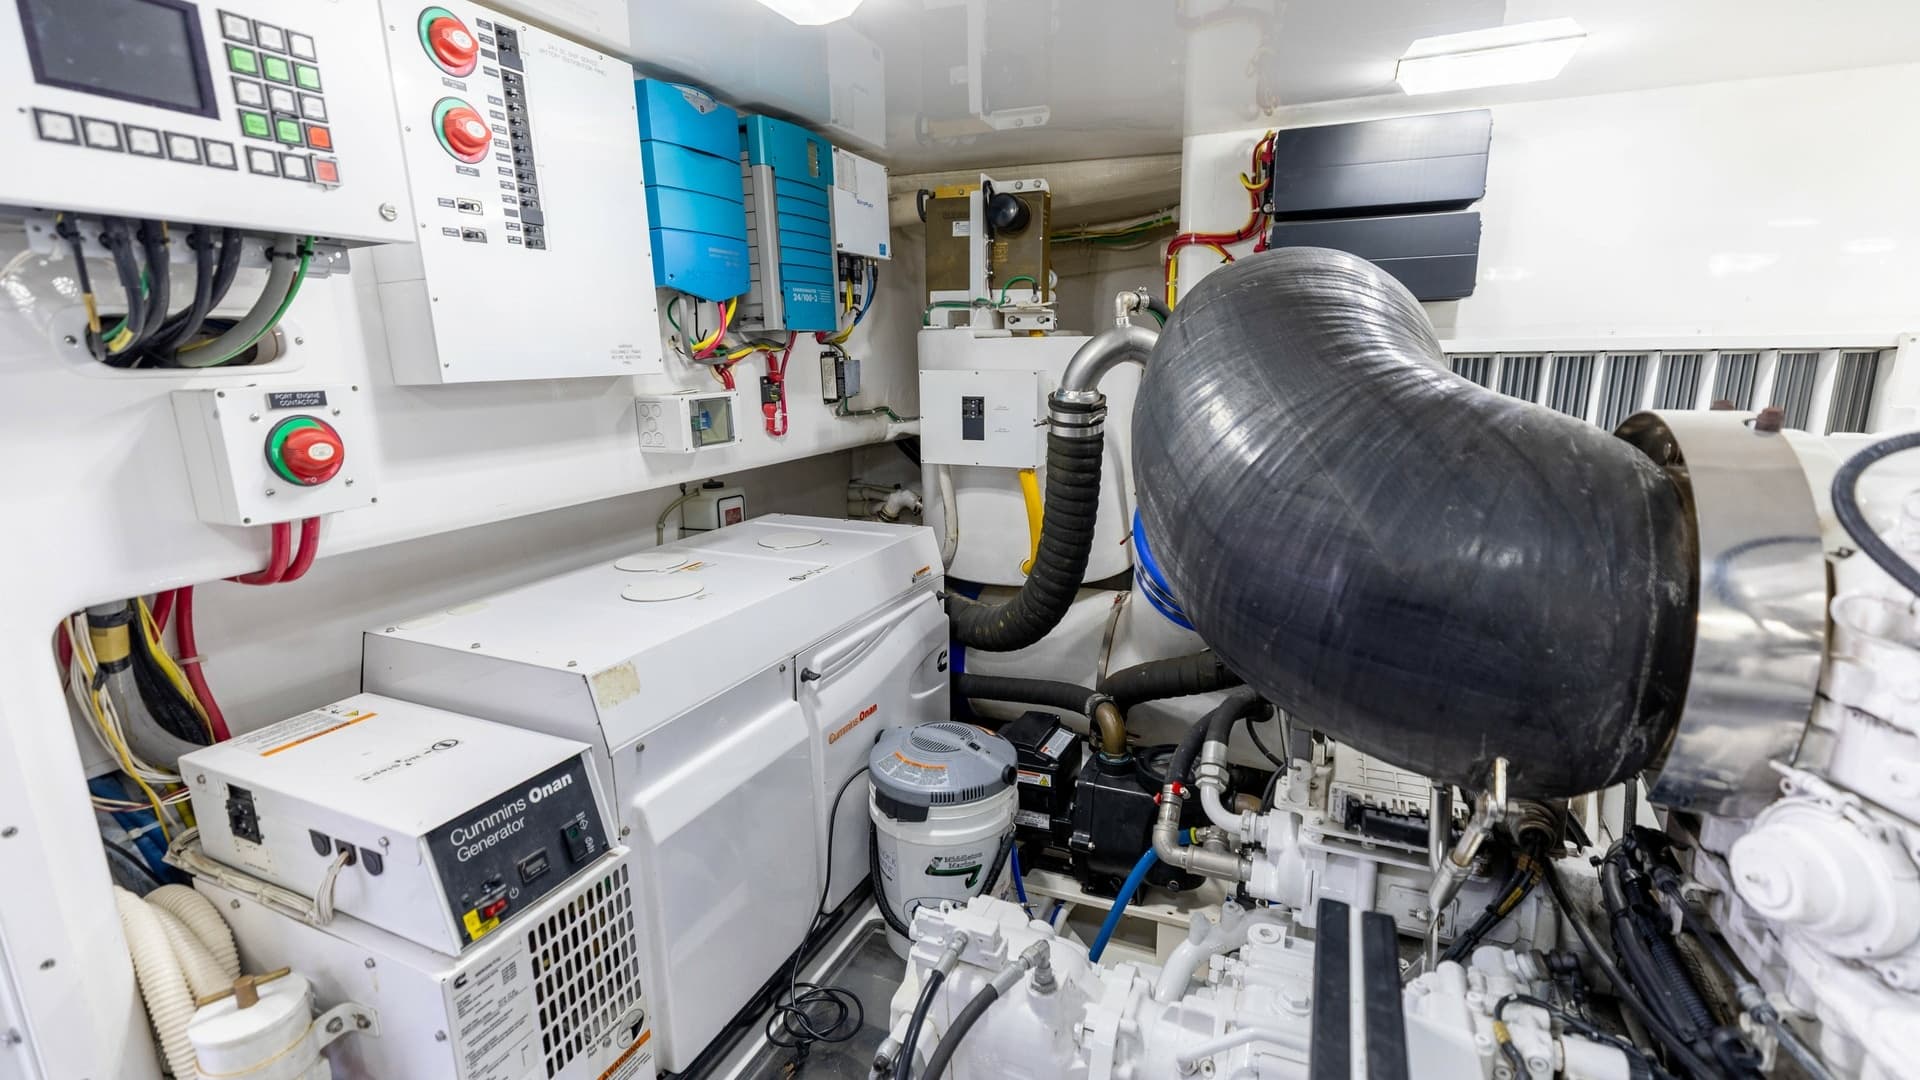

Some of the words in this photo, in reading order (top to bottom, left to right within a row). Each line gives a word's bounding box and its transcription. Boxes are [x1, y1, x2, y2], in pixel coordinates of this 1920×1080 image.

[829, 717, 859, 744] Cummins
[860, 704, 877, 721] Onan
[450, 798, 527, 846] Cummins
[528, 773, 573, 803] Onan
[457, 816, 525, 862] Generator
